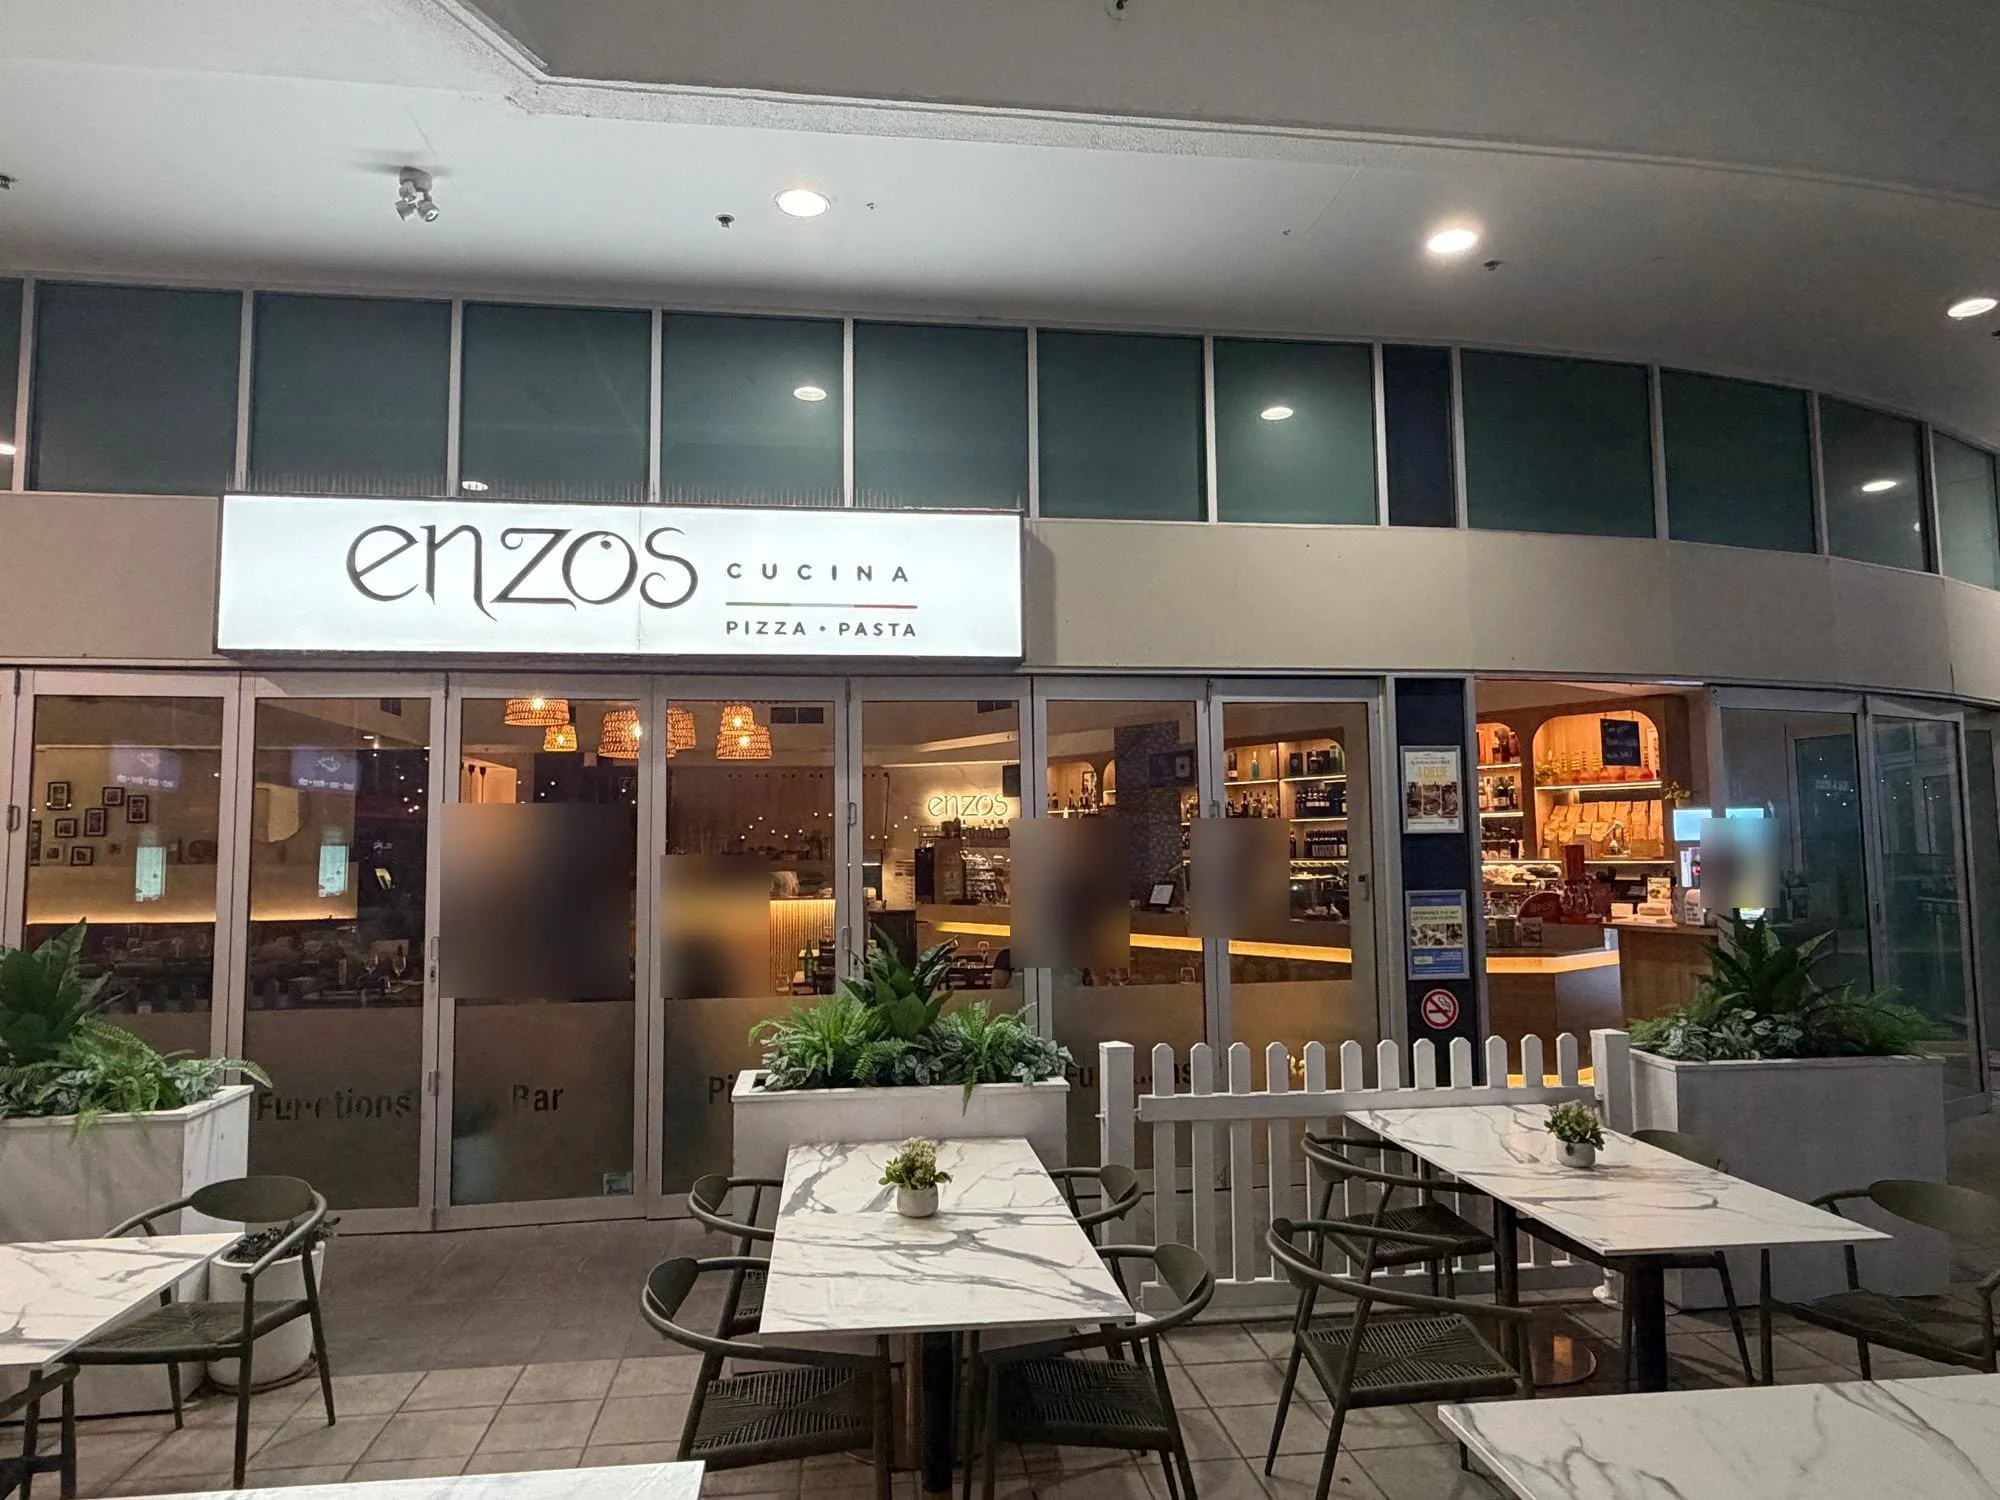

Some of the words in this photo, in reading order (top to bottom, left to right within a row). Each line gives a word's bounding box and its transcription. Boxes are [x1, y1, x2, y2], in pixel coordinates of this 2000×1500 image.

[347, 525, 698, 620] enzos
[726, 562, 908, 582] CUCINA
[726, 621, 806, 635] PIZZA
[838, 622, 916, 637] PASTA
[927, 794, 1008, 817] enzos
[512, 1084, 564, 1112] Bar
